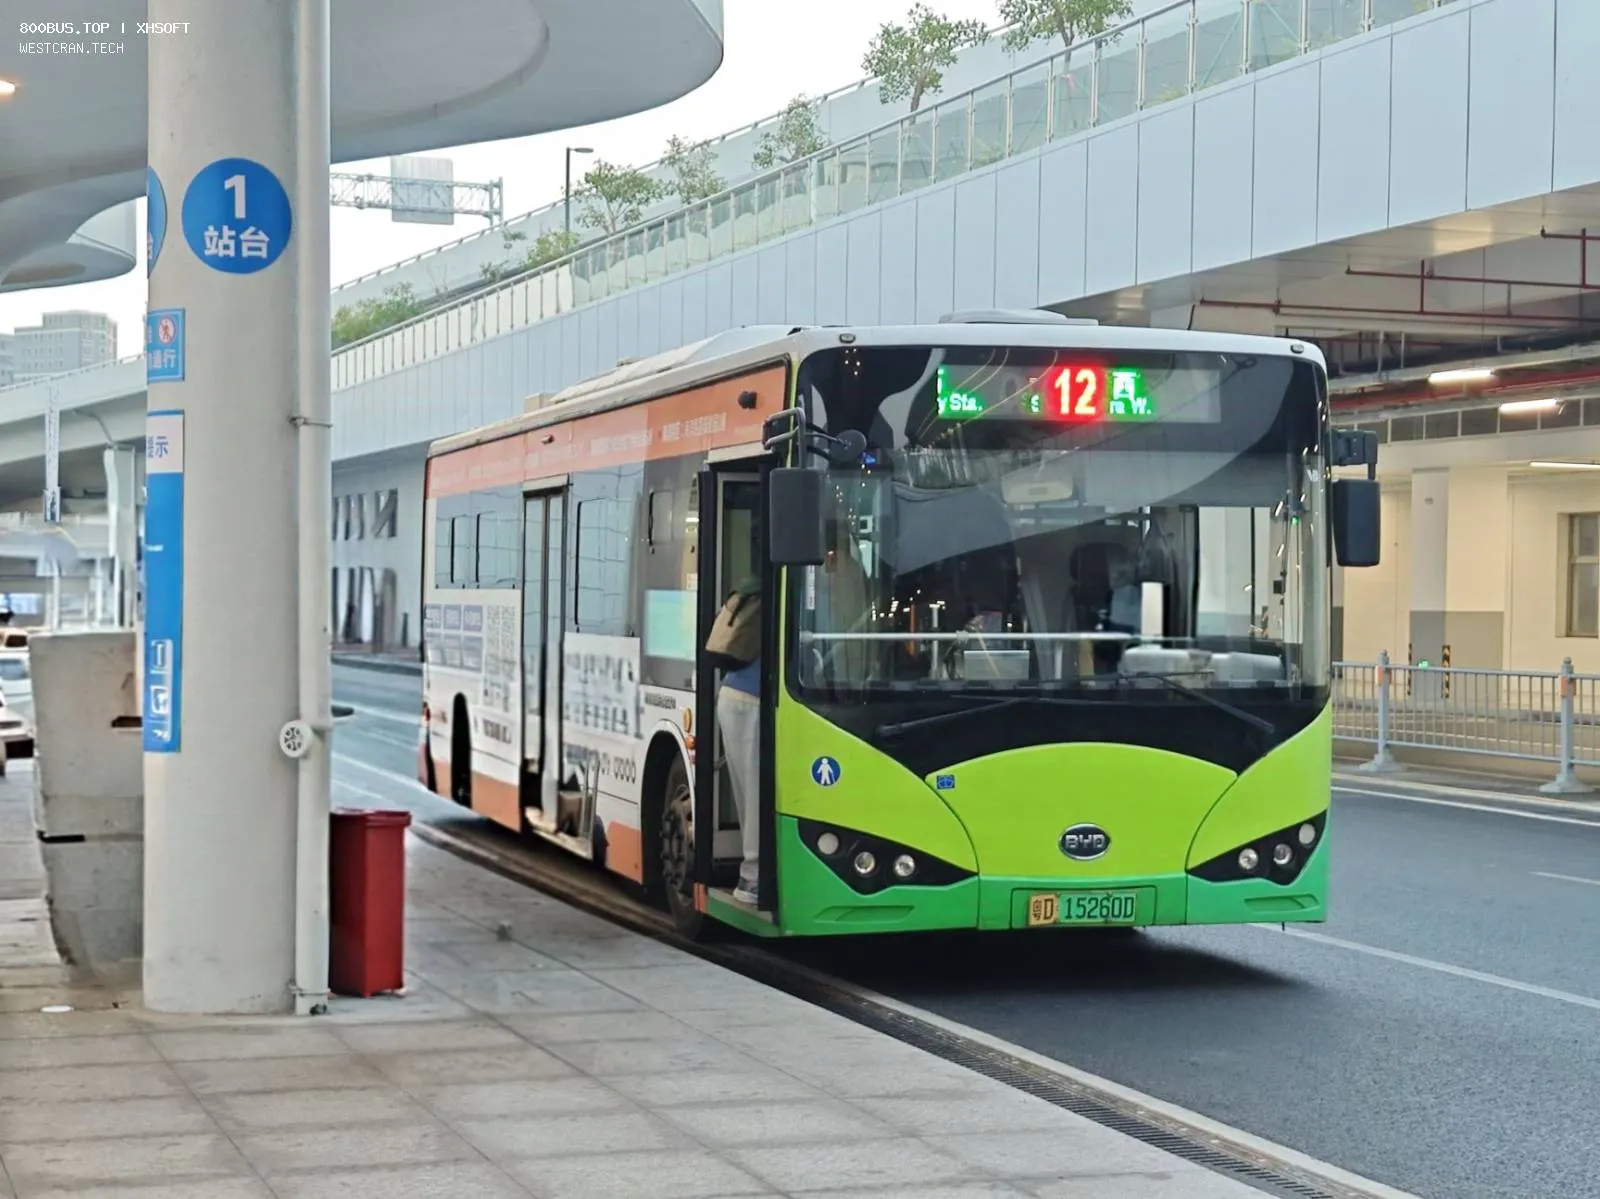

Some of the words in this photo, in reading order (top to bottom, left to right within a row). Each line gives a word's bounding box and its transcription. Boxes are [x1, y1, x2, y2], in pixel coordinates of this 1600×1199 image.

[224, 174, 247, 219] 1
[204, 224, 271, 259] 站台
[1055, 368, 1097, 414] 12
[1065, 834, 1105, 849] BYD
[1065, 897, 1134, 920] 15260D
